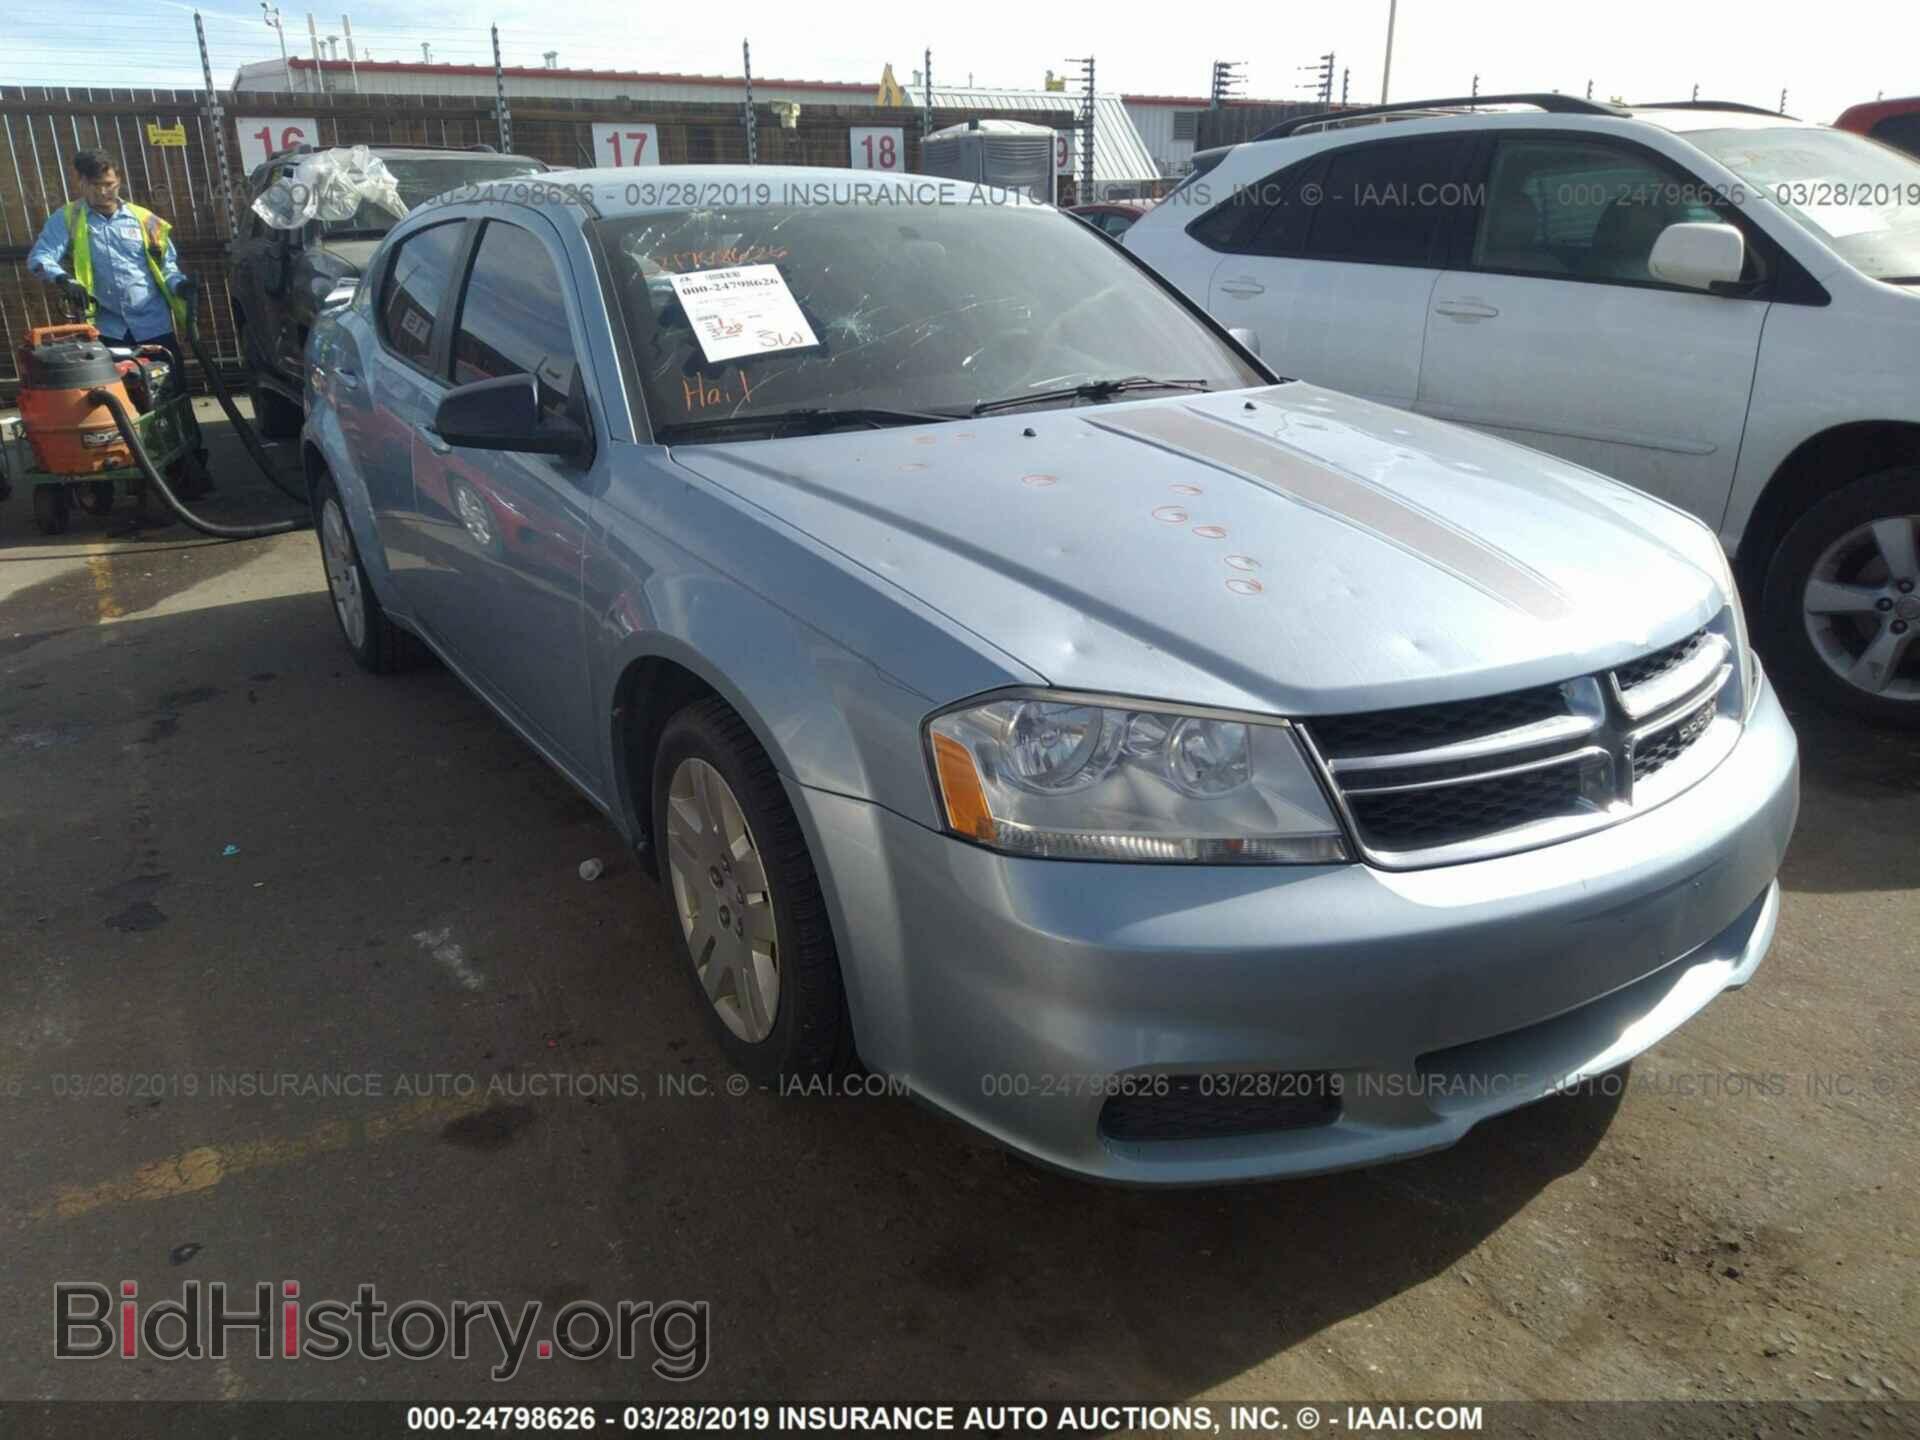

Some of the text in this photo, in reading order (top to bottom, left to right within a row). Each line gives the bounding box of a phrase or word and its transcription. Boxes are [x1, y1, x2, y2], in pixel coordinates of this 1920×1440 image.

[606, 132, 648, 167] 17
[861, 135, 896, 169] 18
[1057, 136, 1068, 168] 9
[681, 371, 752, 411] Hail
